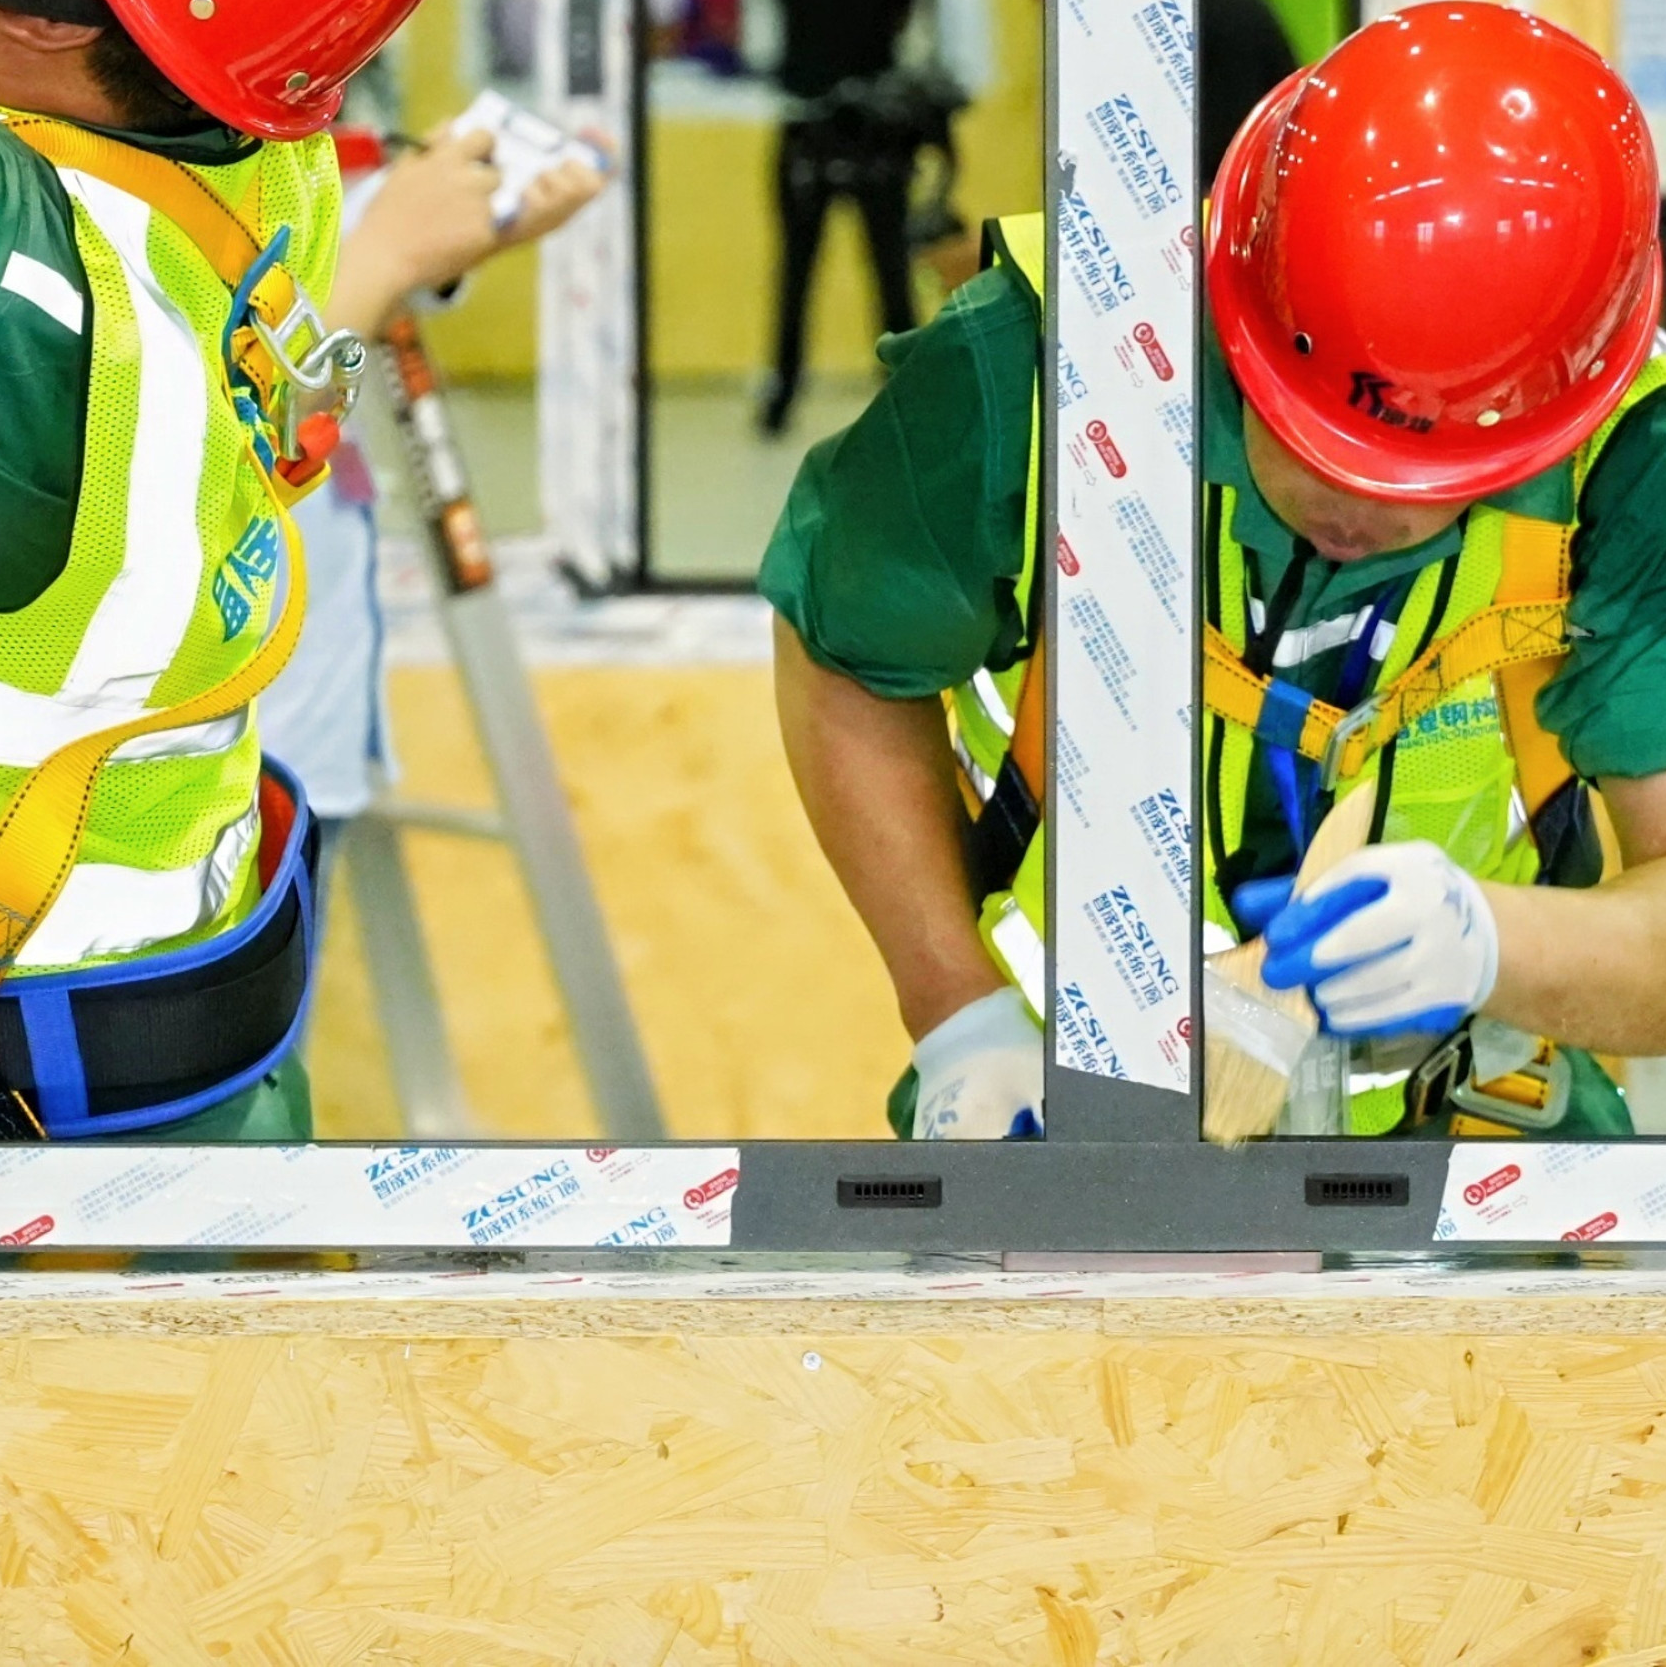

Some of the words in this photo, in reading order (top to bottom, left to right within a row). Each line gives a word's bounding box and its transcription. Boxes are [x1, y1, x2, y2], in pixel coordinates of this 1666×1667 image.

[1113, 93, 1182, 204] ZCSUNG
[1069, 192, 1135, 302] ZCSUNG
[1111, 885, 1179, 995] ZCSUNG
[461, 1159, 571, 1230] ZCSUNG
